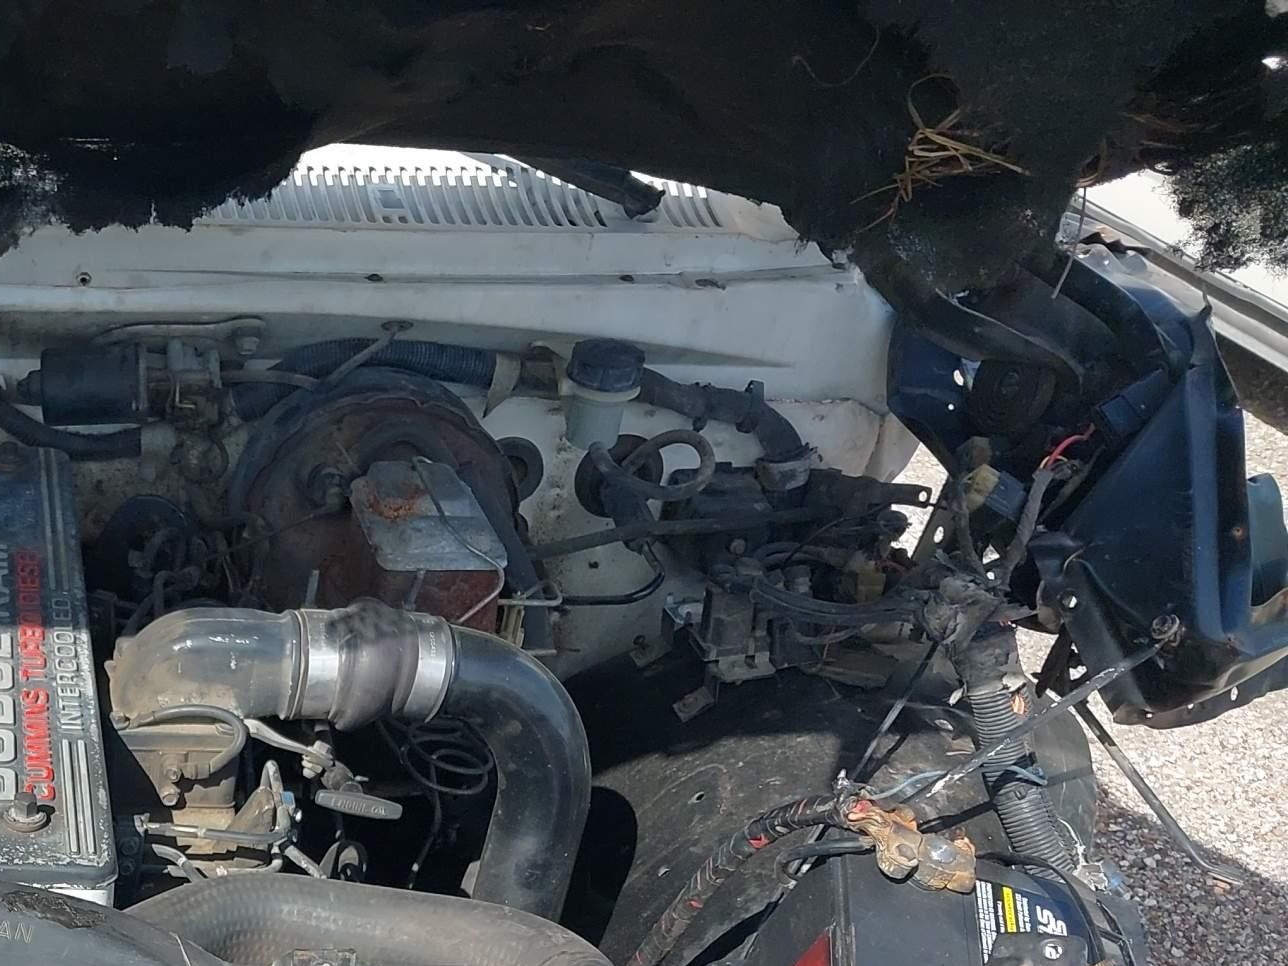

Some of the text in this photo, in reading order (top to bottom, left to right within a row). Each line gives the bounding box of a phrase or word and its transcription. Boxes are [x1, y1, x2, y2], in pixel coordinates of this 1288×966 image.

[18, 612, 48, 681] TURBO
[52, 598, 85, 731] INTERCOOLED
[23, 687, 56, 801] CUMMINS
